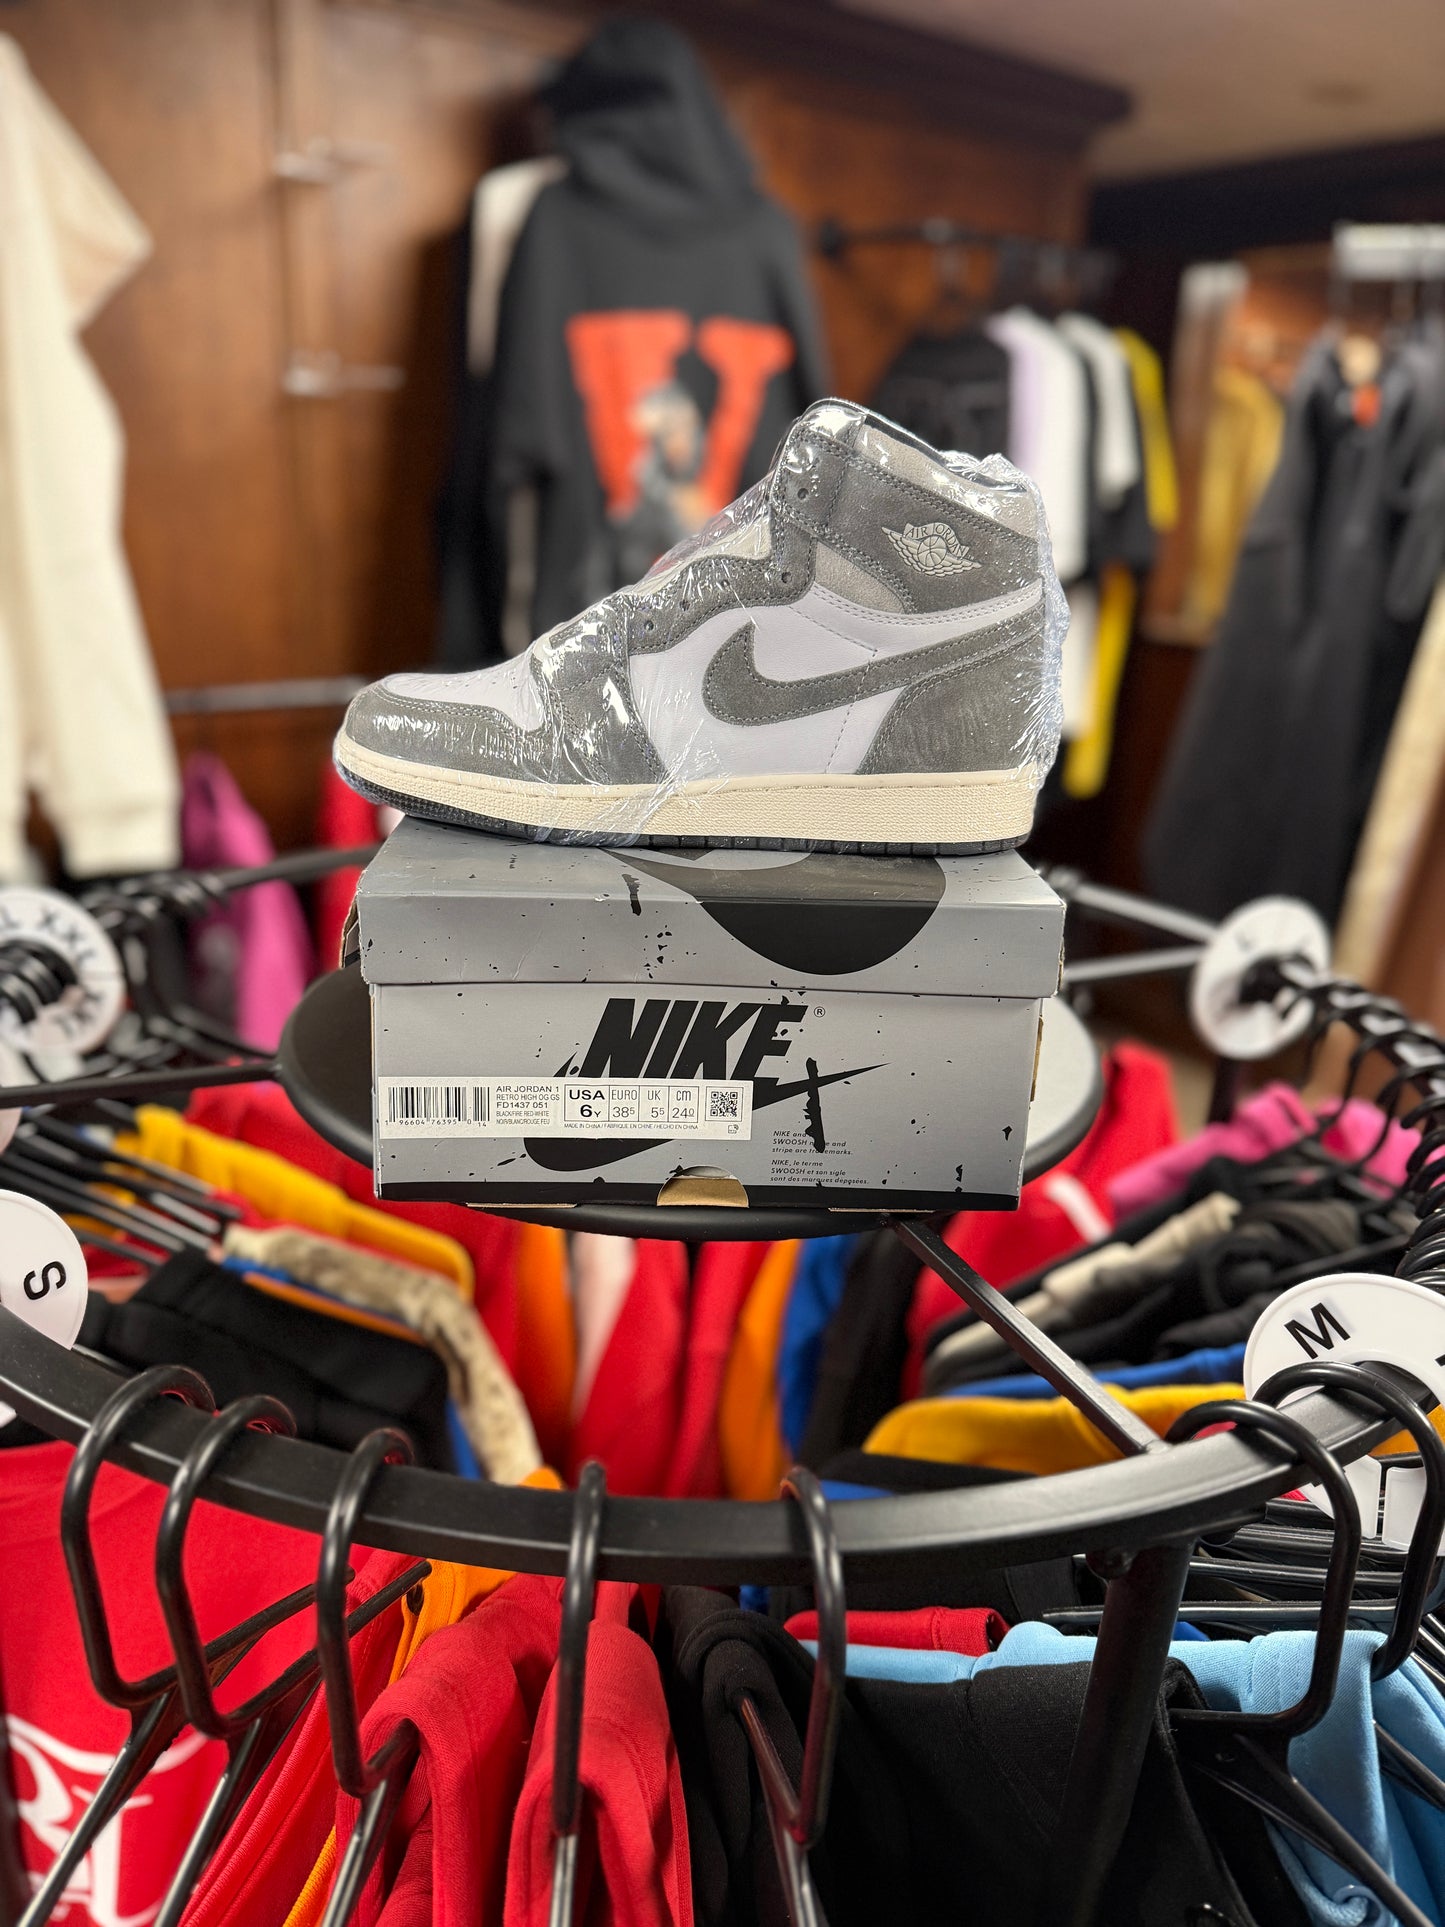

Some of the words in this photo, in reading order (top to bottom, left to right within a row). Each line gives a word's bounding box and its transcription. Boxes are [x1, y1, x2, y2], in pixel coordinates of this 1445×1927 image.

[905, 526, 928, 539] AIR
[932, 523, 968, 557] JORDAN
[577, 998, 809, 1086] NIKE
[496, 1085, 512, 1093] AIR
[514, 1085, 552, 1093] JORDAN
[555, 1085, 559, 1093] 1
[496, 1093, 519, 1101] RETRO
[520, 1093, 537, 1101] HIGH
[569, 1089, 605, 1100] USA
[611, 1089, 638, 1101] EURO
[647, 1090, 661, 1101] UK
[496, 1101, 530, 1109] FD1437
[532, 1101, 548, 1109] 051
[399, 1118, 425, 1126] 96604
[431, 1118, 457, 1126] 76395
[772, 1138, 808, 1146] SWOOSH
[809, 1148, 853, 1156] traemarks.
[770, 1167, 806, 1175] SWOOSH
[829, 1169, 846, 1177] sigle
[23, 1260, 67, 1301] S
[1284, 1302, 1351, 1360] M
